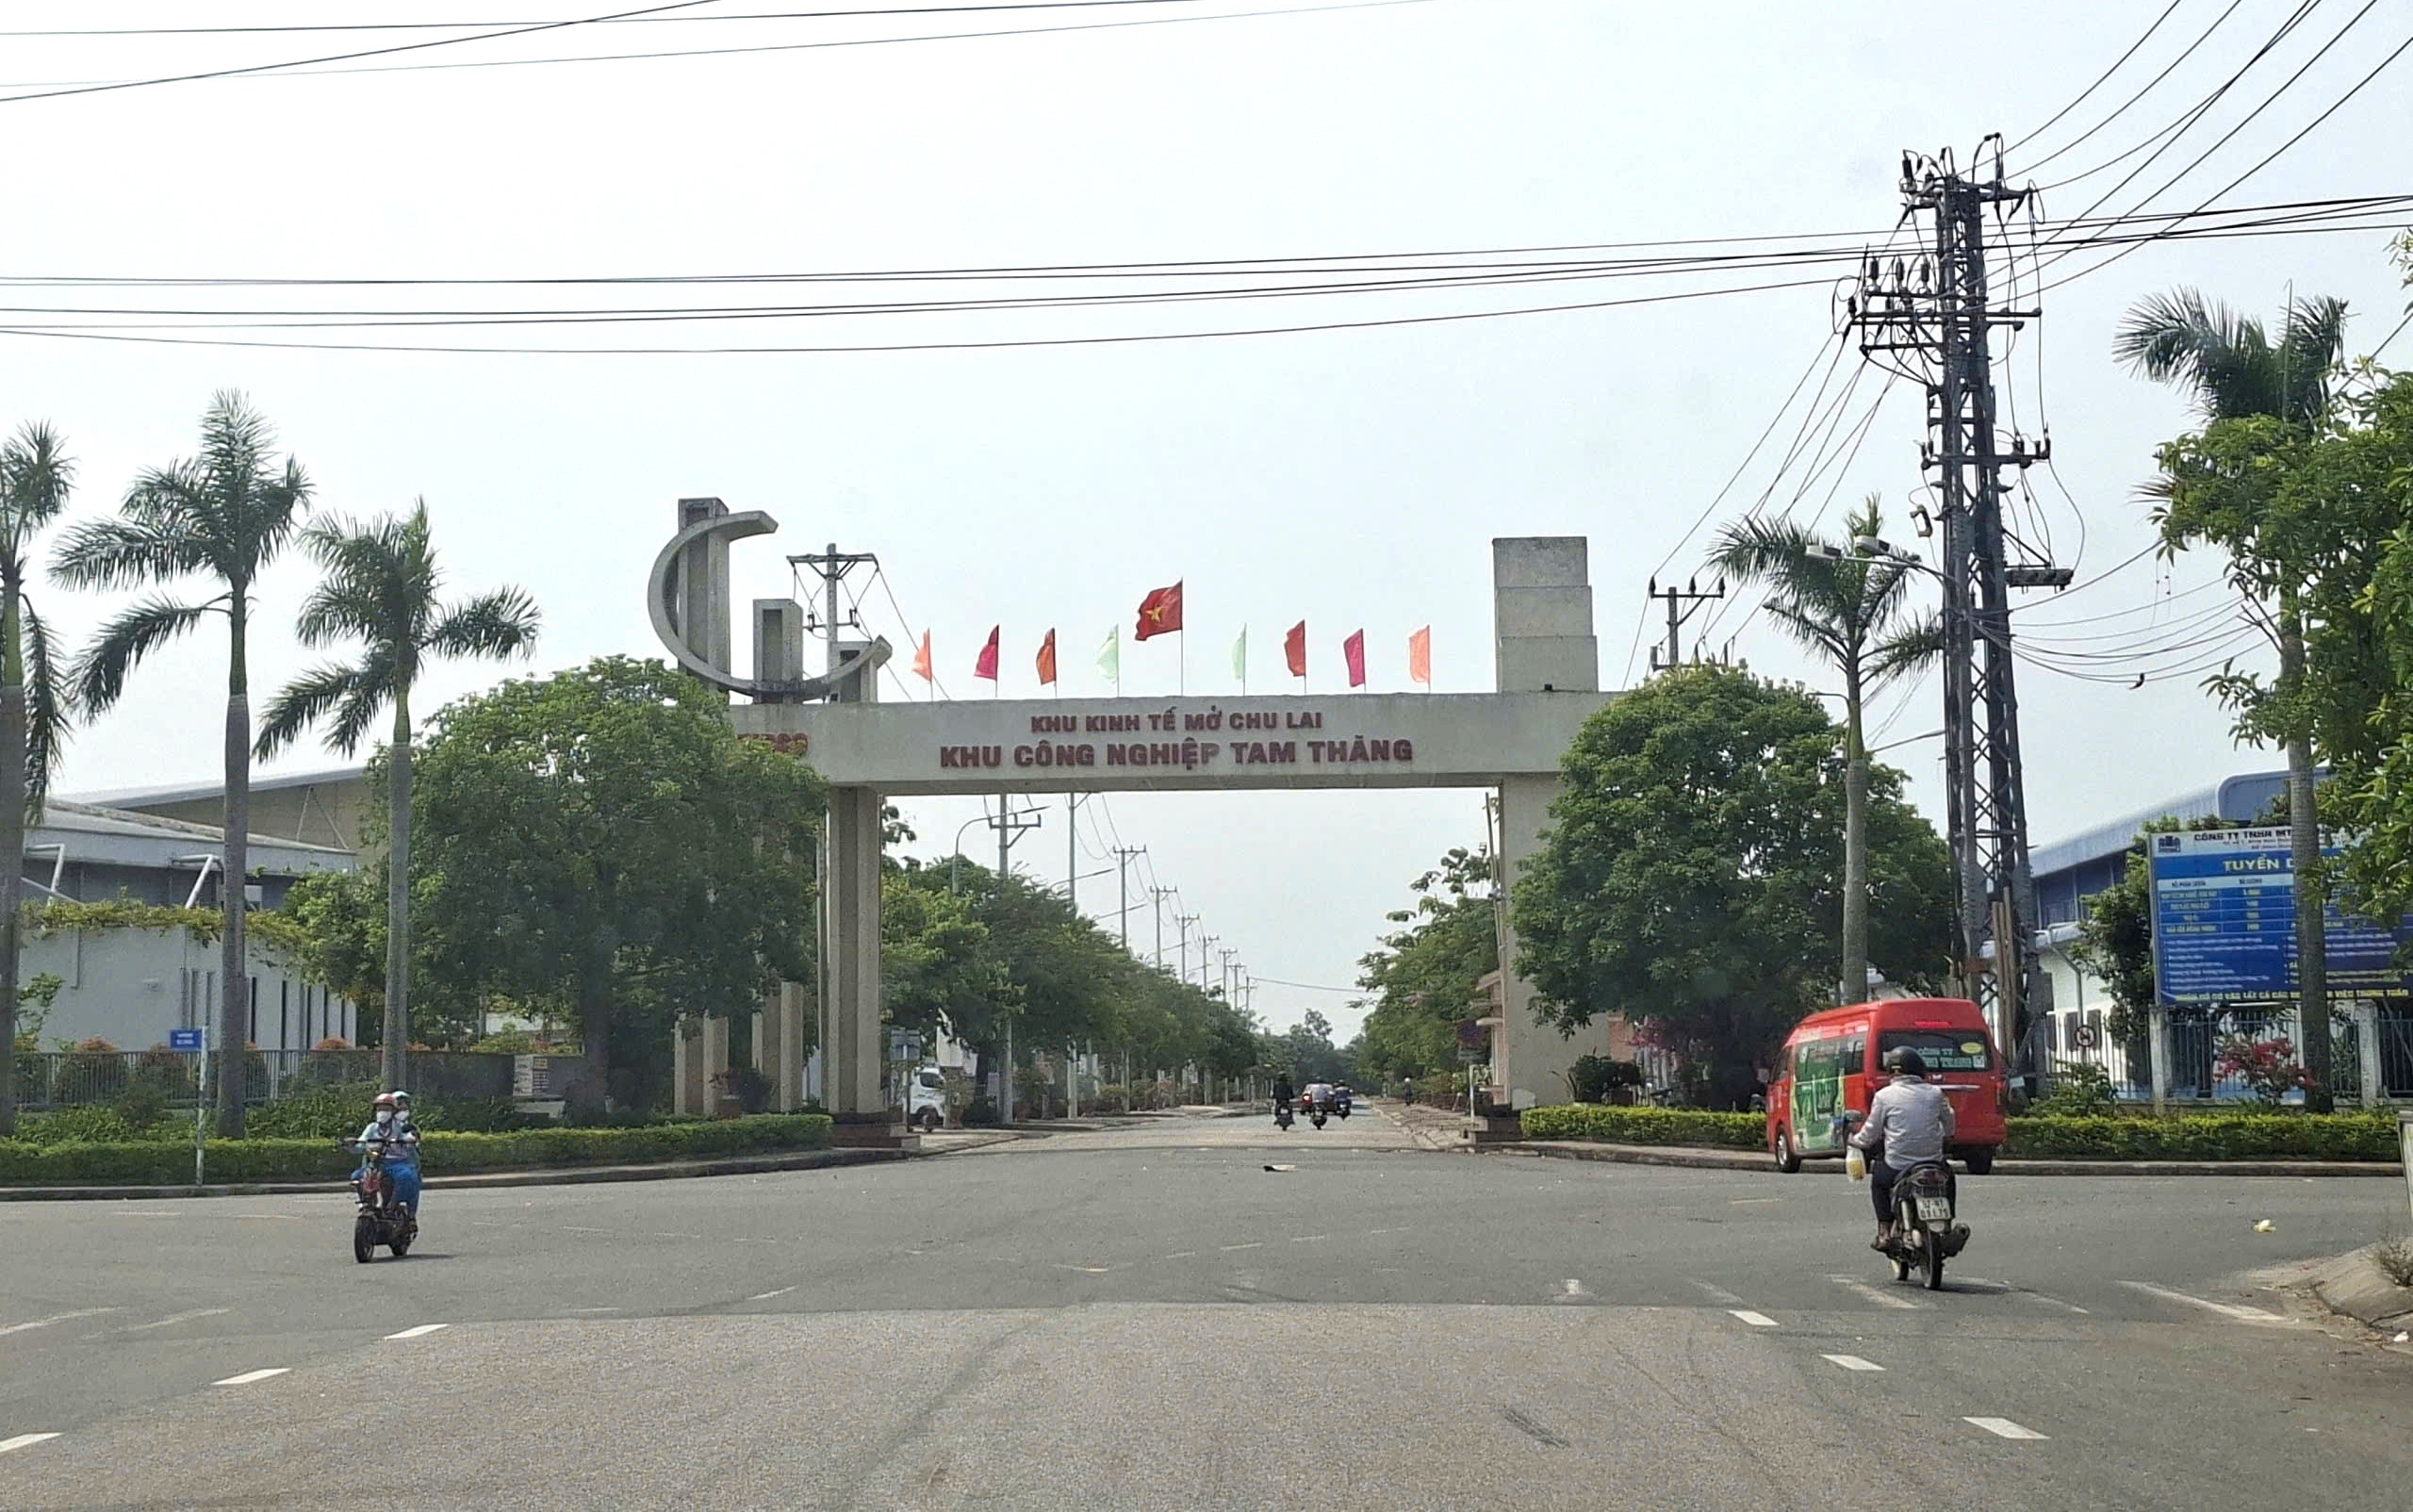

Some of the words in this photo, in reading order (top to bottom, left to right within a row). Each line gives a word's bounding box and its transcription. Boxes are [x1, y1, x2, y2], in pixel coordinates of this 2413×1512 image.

[1030, 715, 1076, 732] KHU
[1085, 715, 1140, 731] KINH
[1148, 706, 1176, 731] TẾ
[1184, 705, 1222, 731] MỞ
[1229, 712, 1277, 730] CHU
[1287, 712, 1322, 729] LAI
[940, 746, 1002, 767] KHU
[1013, 739, 1095, 767] CÔNG
[1107, 737, 1221, 770] NGHIỆP
[1229, 741, 1296, 764] TAM
[1306, 734, 1413, 763] THĂNG
[2193, 832, 2224, 842] CÔNG
[2227, 831, 2240, 841] TY
[2223, 852, 2280, 872] TUYỂN
